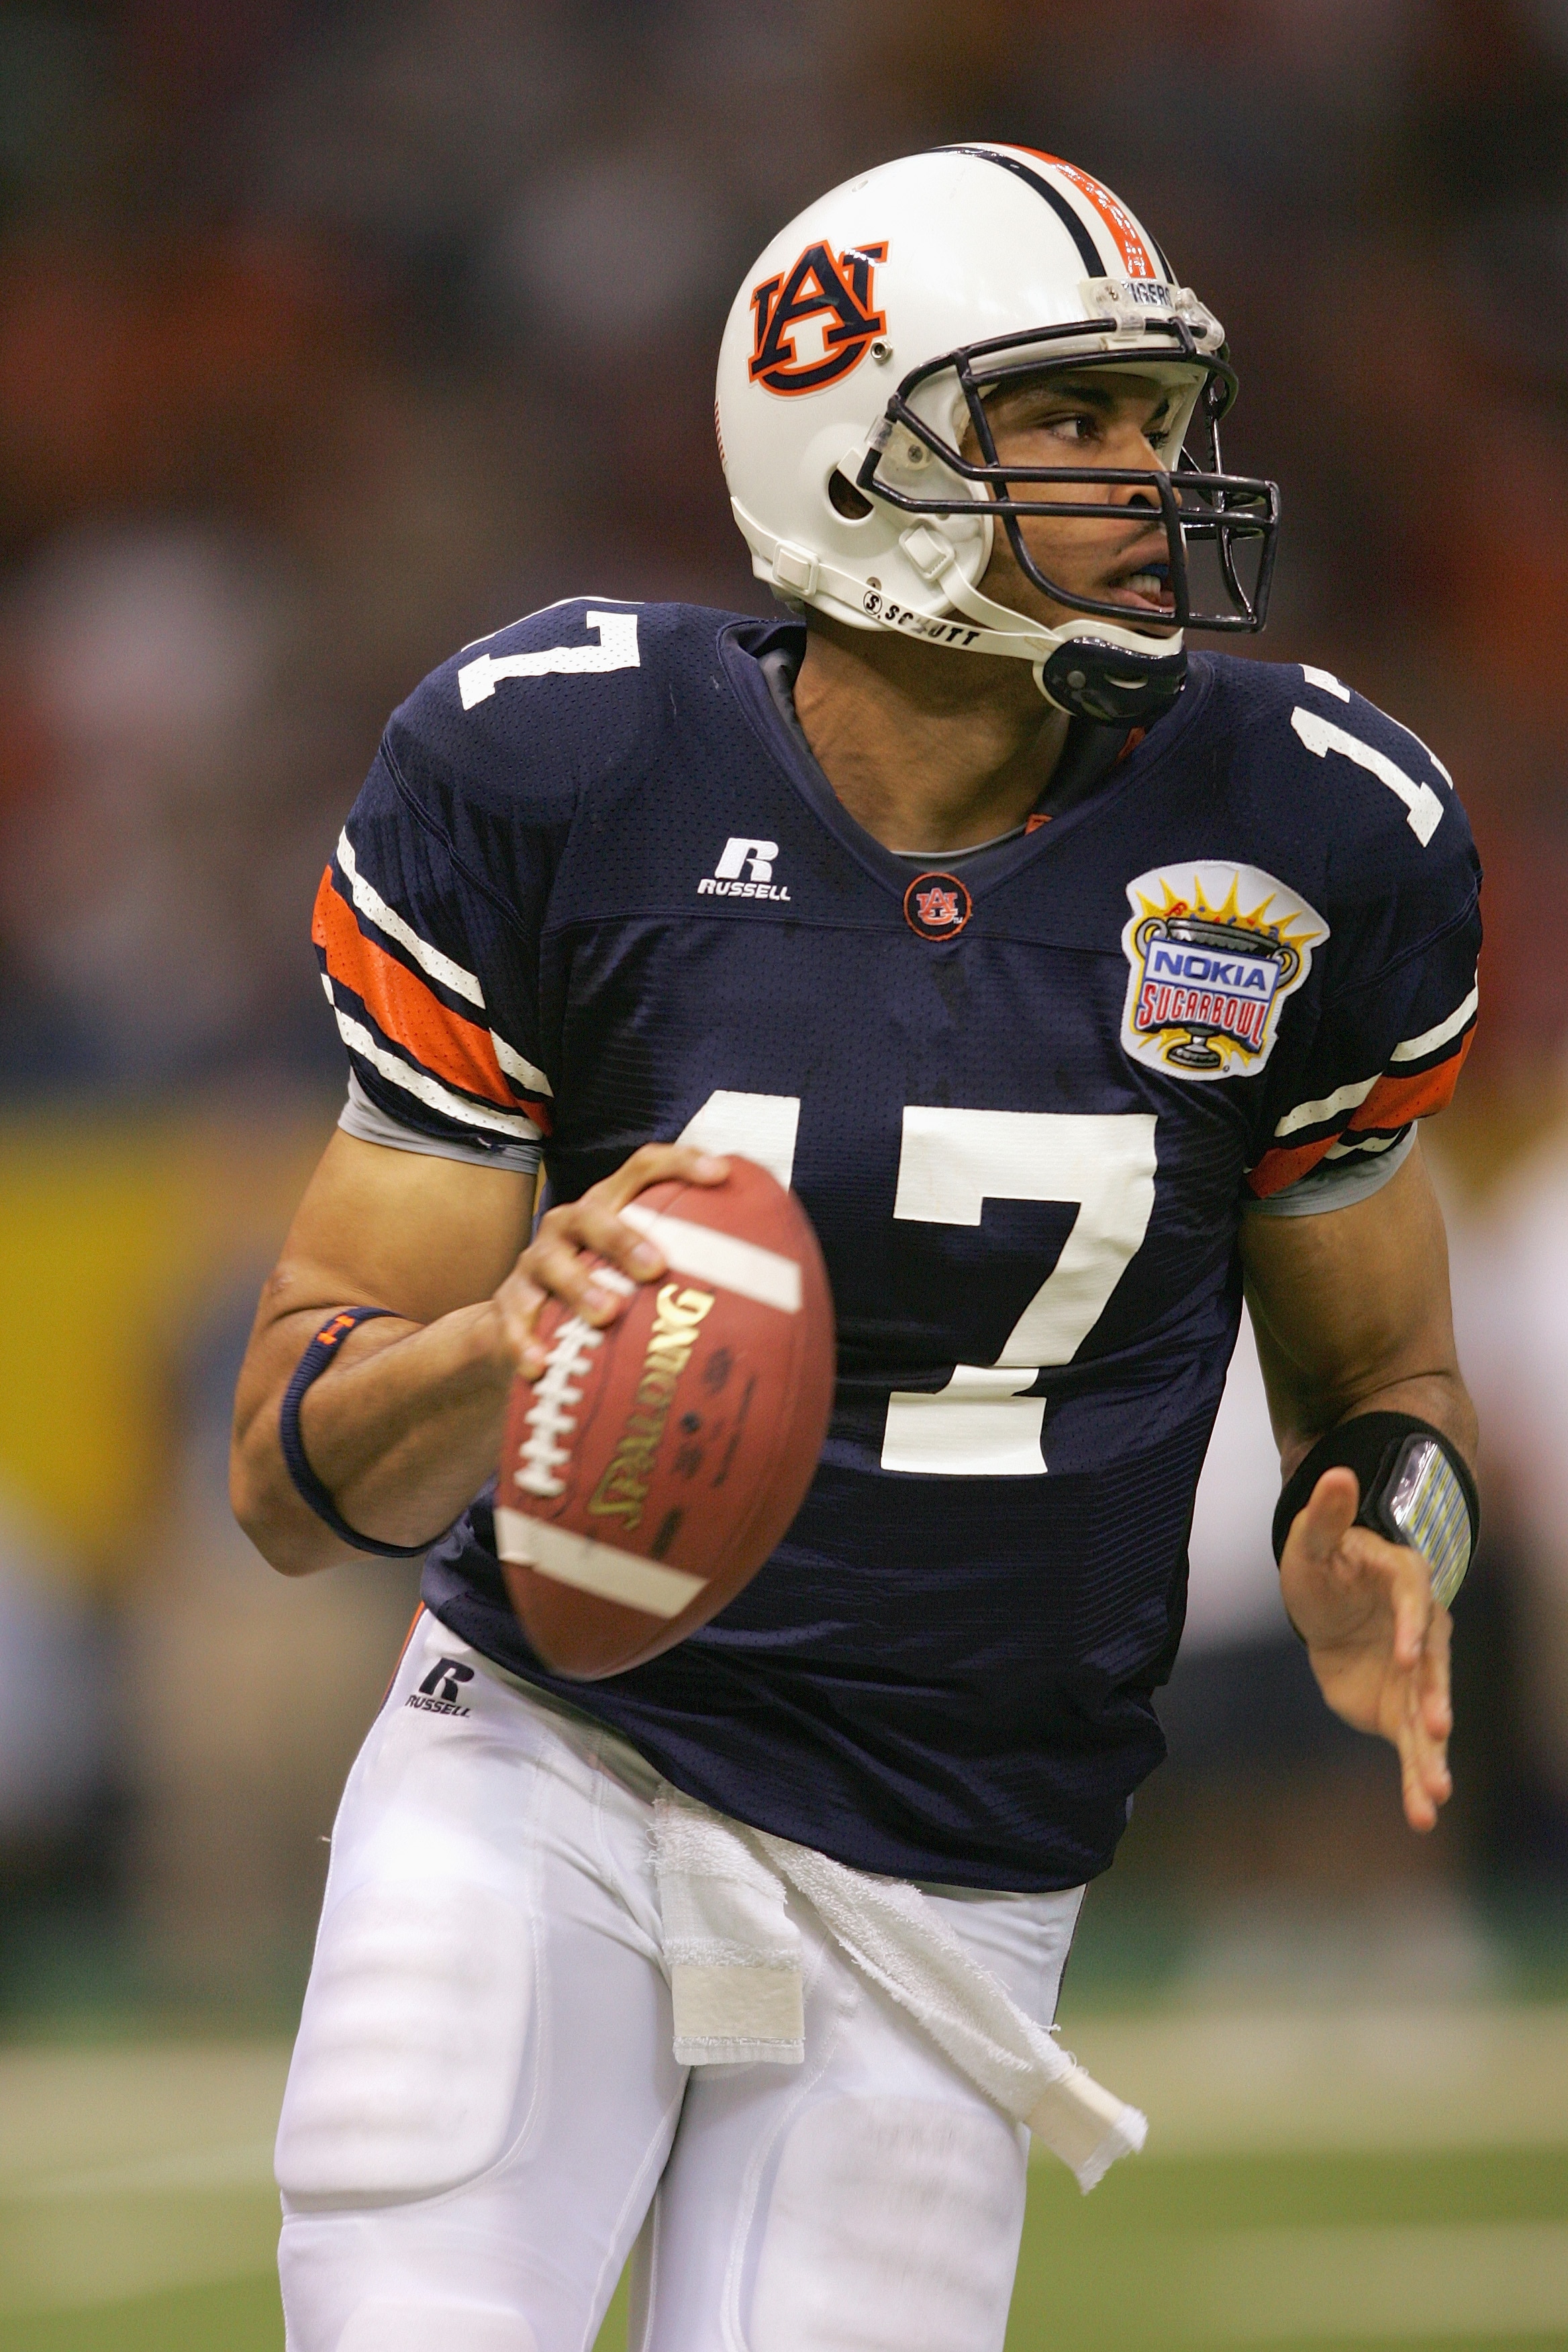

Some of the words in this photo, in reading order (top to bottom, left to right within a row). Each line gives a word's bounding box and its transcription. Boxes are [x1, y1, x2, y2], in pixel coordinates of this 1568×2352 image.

[885, 604, 981, 646] SCUTT
[715, 838, 779, 883] R
[697, 878, 791, 901] RUSSELL
[1154, 950, 1267, 991] NOKIA
[419, 1657, 475, 1703] R
[404, 1695, 471, 1718] RUSSELL
